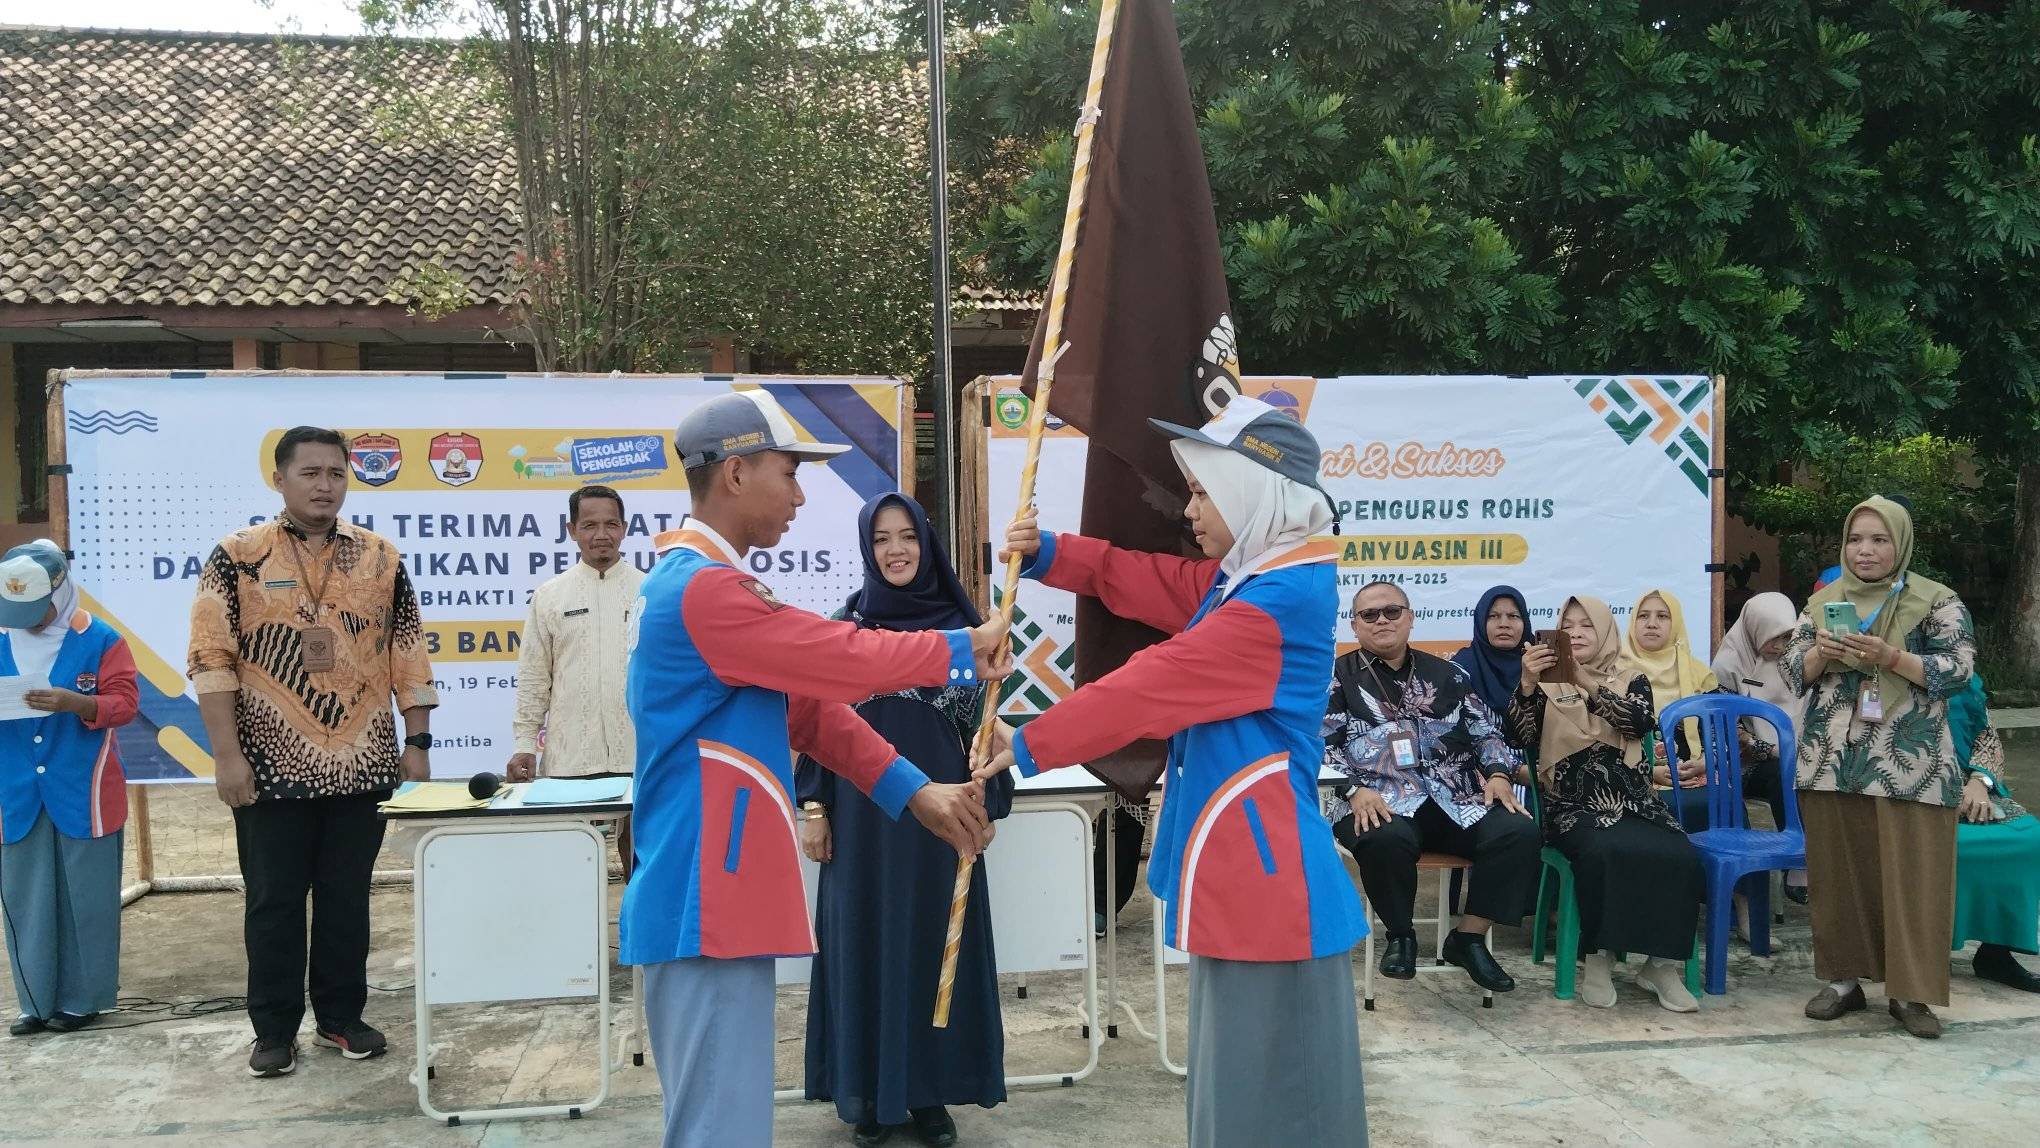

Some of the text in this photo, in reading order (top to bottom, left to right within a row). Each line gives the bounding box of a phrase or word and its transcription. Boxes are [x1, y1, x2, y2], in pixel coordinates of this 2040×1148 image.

[579, 440, 634, 460] SEKOLAH
[1322, 442, 1505, 479] at & Sukses
[581, 451, 651, 473] PENGGERAK
[1339, 498, 1554, 520] PENGURUS ROHIS
[393, 513, 541, 538] TERIMA
[1343, 539, 1503, 561] ANYUASIN III
[153, 556, 201, 580] DA
[750, 550, 831, 573] OSIS
[1336, 573, 1448, 586] AKTI 2024-2025
[421, 589, 514, 606] BHAKTI
[1057, 614, 1074, 625] Me
[1415, 607, 1433, 620] uju
[1437, 607, 1475, 620] presta
[425, 630, 521, 654] 3 BAN
[460, 677, 478, 690] 19
[487, 675, 518, 689] Feb
[433, 735, 492, 748] antiba
